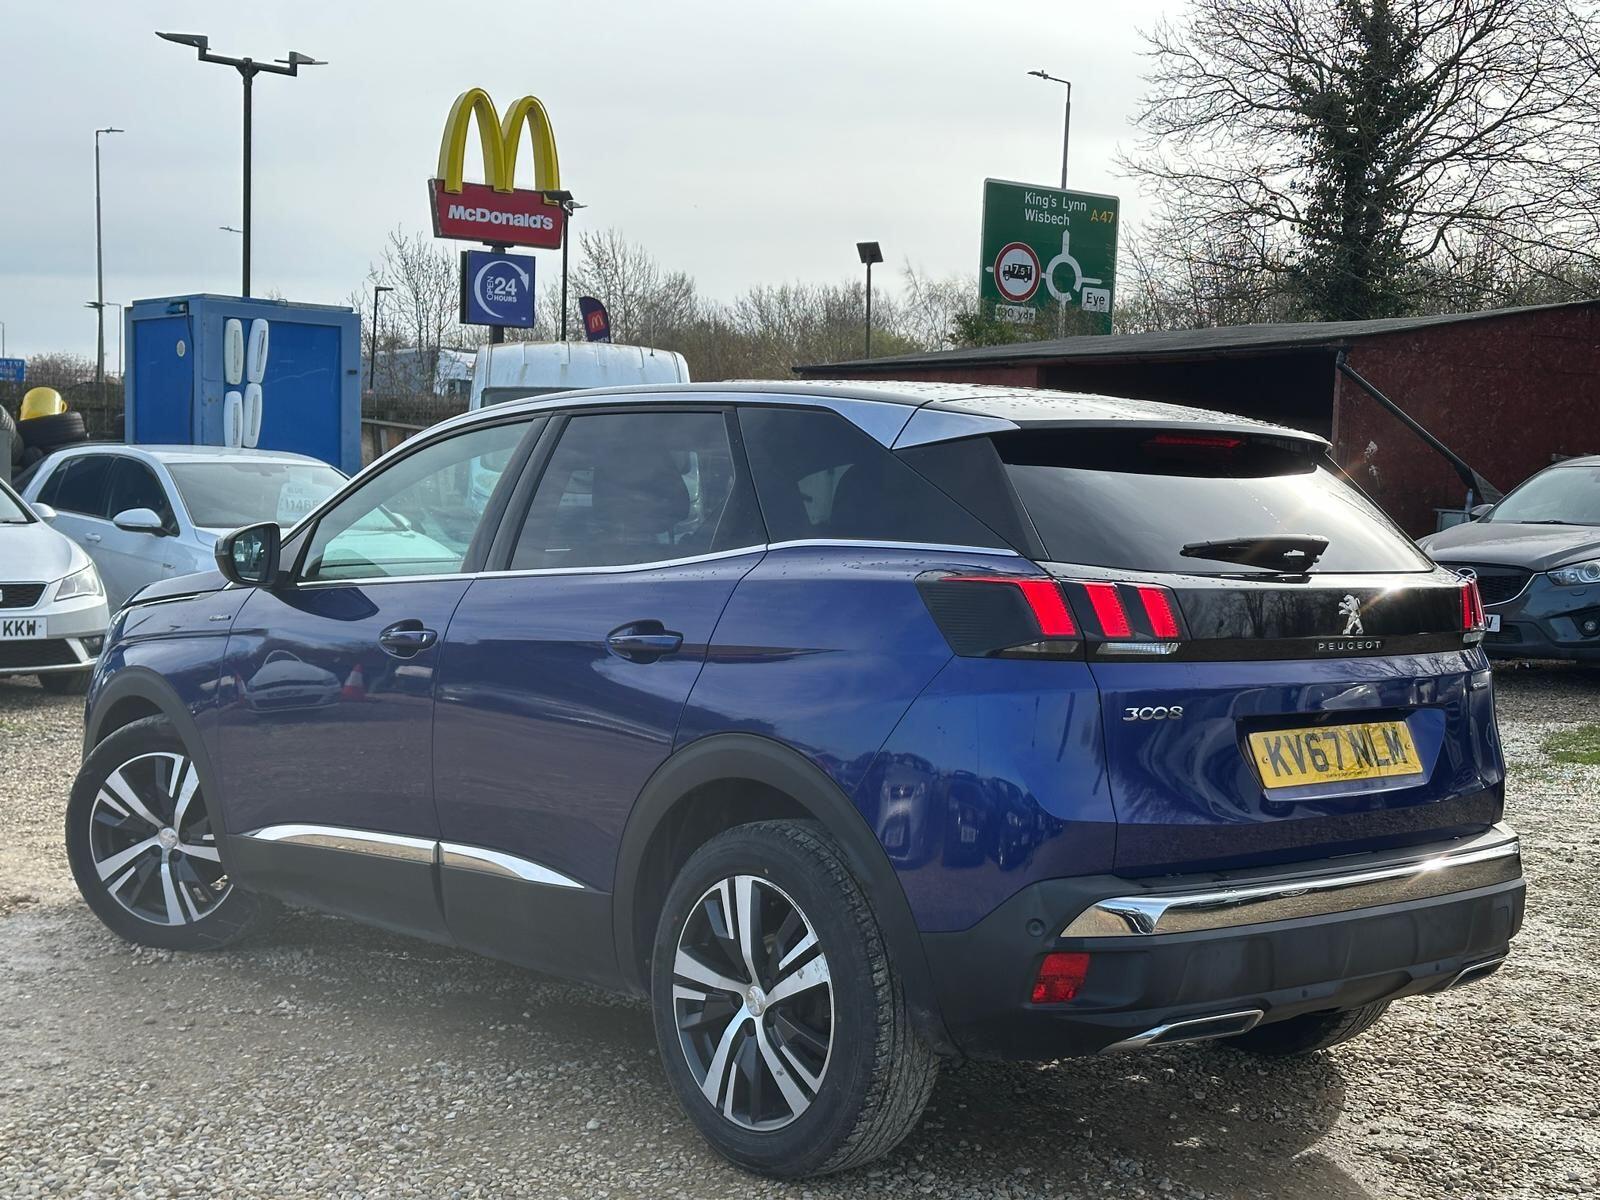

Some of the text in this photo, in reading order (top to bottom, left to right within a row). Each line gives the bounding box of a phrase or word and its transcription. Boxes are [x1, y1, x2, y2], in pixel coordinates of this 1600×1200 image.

[1024, 191, 1087, 212] King's Lynn
[447, 204, 554, 230] McDonald's
[1024, 208, 1070, 226] Wisbech
[486, 276, 494, 301] OPEN
[494, 277, 518, 295] 24
[493, 294, 518, 303] HOURS
[1086, 292, 1105, 306] Eye
[2, 620, 37, 637] KKW
[1318, 640, 1381, 651] PEUGEOT
[1122, 705, 1184, 721] 3008
[1262, 726, 1408, 777] KV67 NLM
